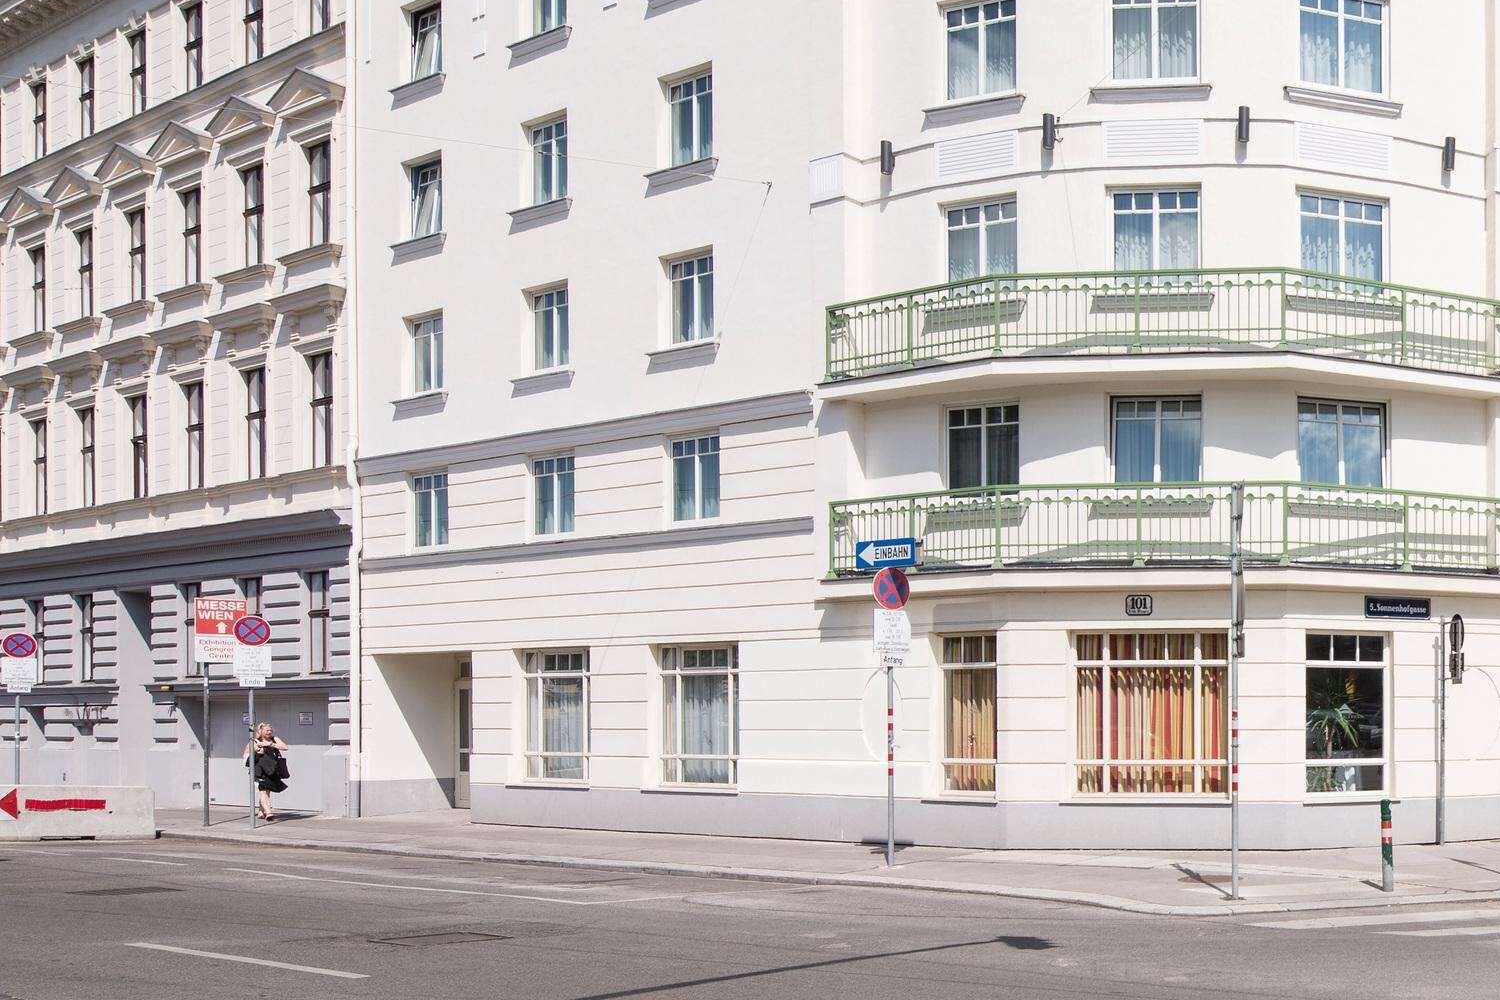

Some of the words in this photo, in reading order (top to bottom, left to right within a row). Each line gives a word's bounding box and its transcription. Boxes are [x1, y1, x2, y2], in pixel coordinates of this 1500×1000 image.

[874, 546, 909, 560] EINBAHN
[197, 600, 245, 610] MESSE
[1130, 597, 1148, 609] 101
[1377, 603, 1427, 614] Sonnenhofgasse
[198, 610, 234, 620] WIEN
